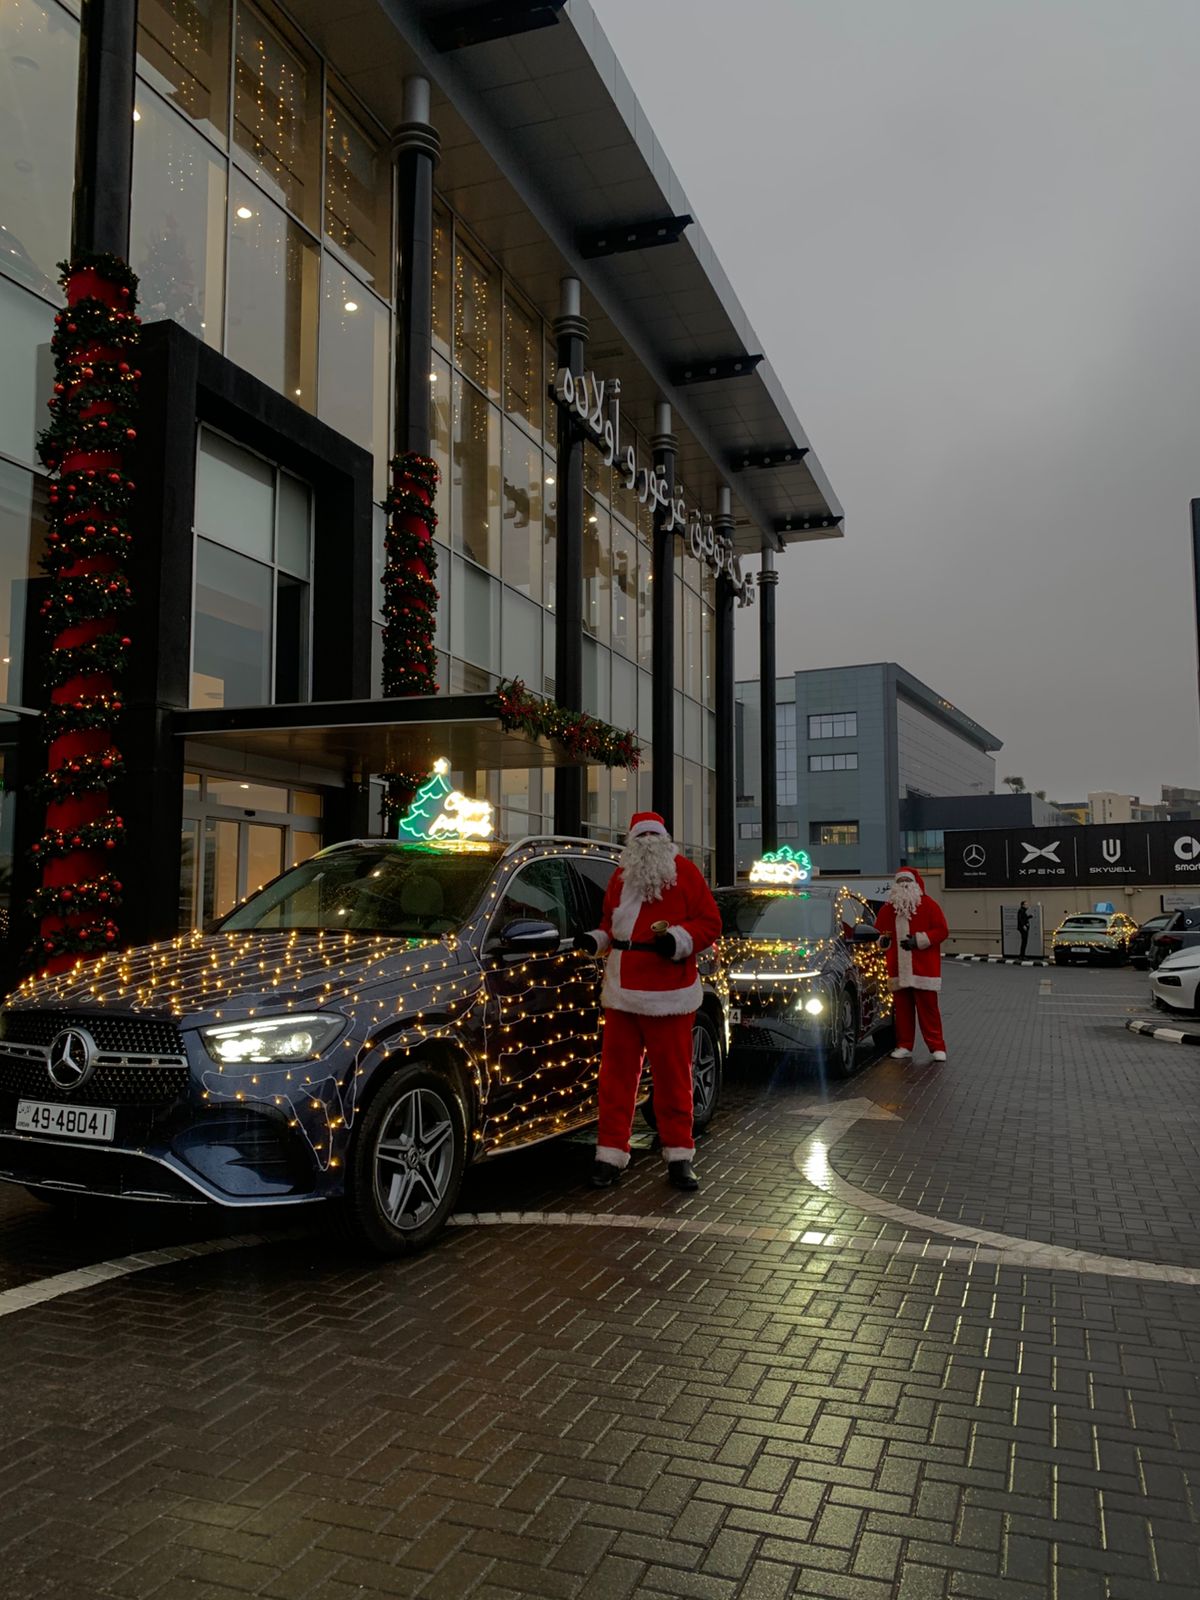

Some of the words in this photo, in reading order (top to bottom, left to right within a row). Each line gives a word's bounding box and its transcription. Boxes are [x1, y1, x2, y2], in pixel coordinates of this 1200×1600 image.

[638, 462, 686, 531] غرغور
[690, 508, 724, 578] توفيق
[1089, 866, 1136, 874] SKYWELL
[31, 1107, 107, 1136] 49-48041
